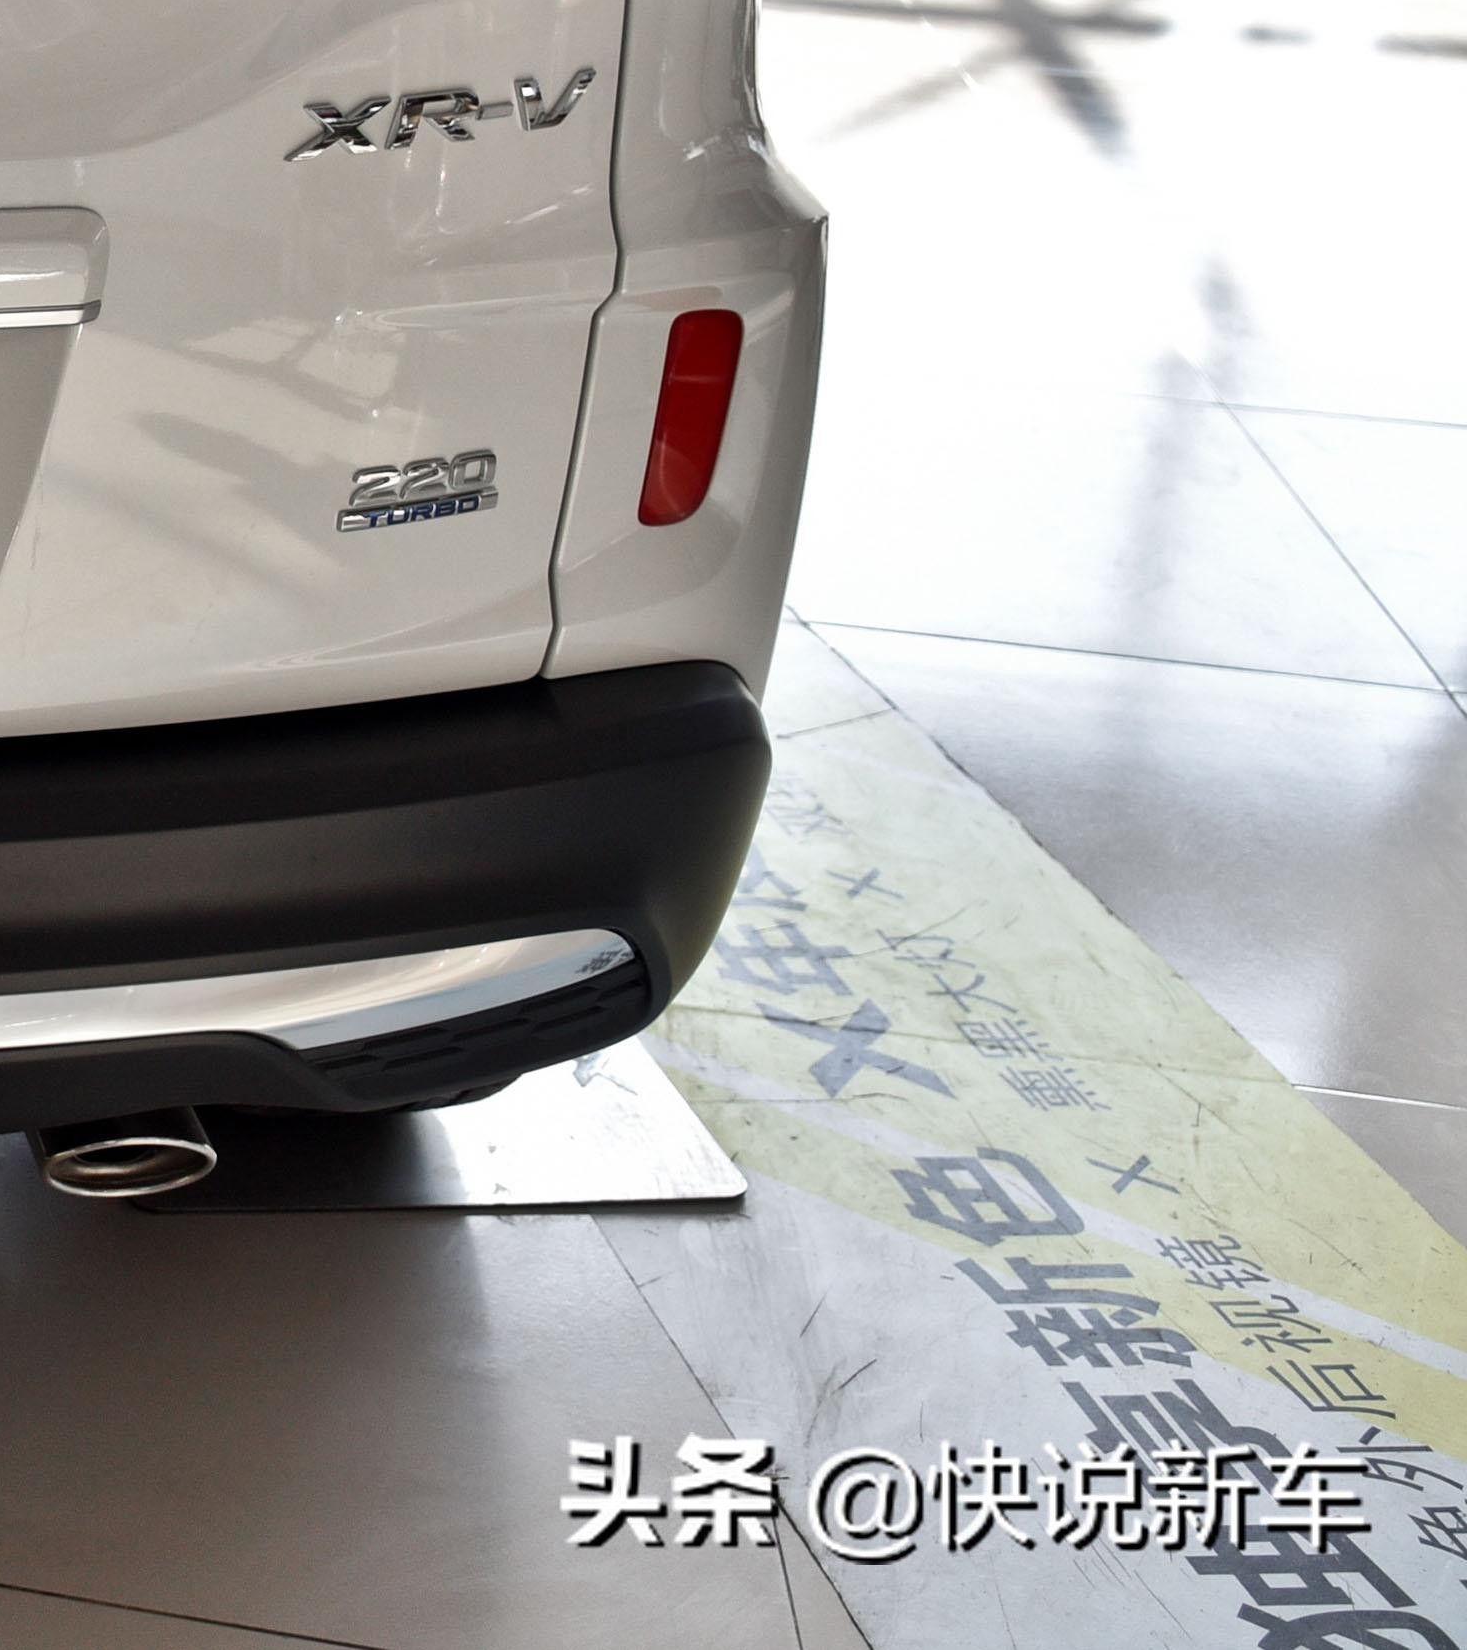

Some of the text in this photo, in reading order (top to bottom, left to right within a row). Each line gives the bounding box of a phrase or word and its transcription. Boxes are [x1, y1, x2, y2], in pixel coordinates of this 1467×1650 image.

[283, 67, 598, 162] XR-V
[348, 448, 498, 508] 220
[361, 494, 483, 530] TURBO
